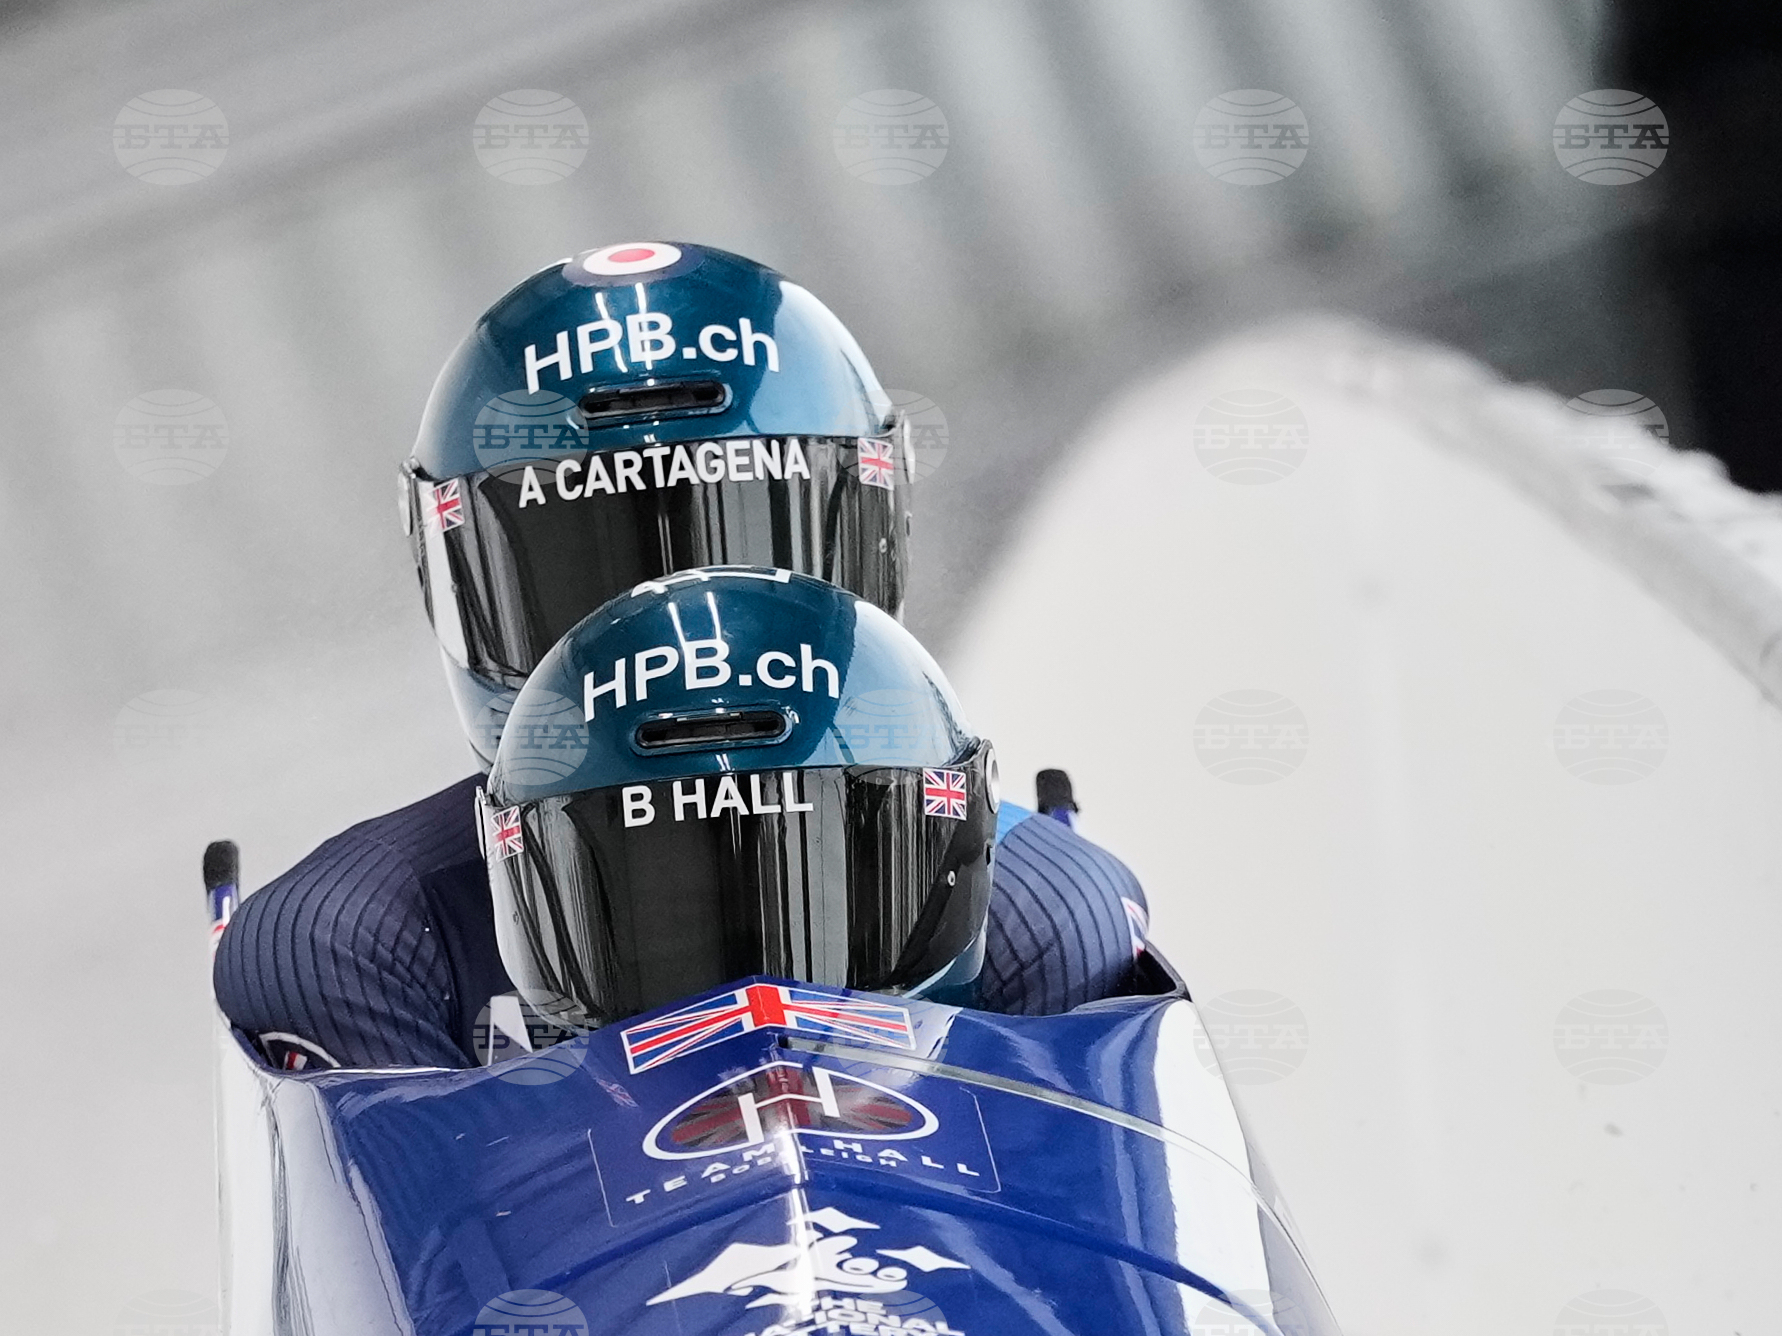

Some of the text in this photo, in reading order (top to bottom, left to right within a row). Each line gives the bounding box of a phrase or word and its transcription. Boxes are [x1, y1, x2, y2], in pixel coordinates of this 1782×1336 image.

[523, 311, 780, 394] HPB.ch
[518, 438, 811, 509] A CARTAGENA
[583, 639, 840, 723] HPB.ch
[621, 772, 814, 828] B HALL
[626, 1139, 980, 1204] TEAM HALL
[711, 1145, 897, 1183] BOBLEIGH
